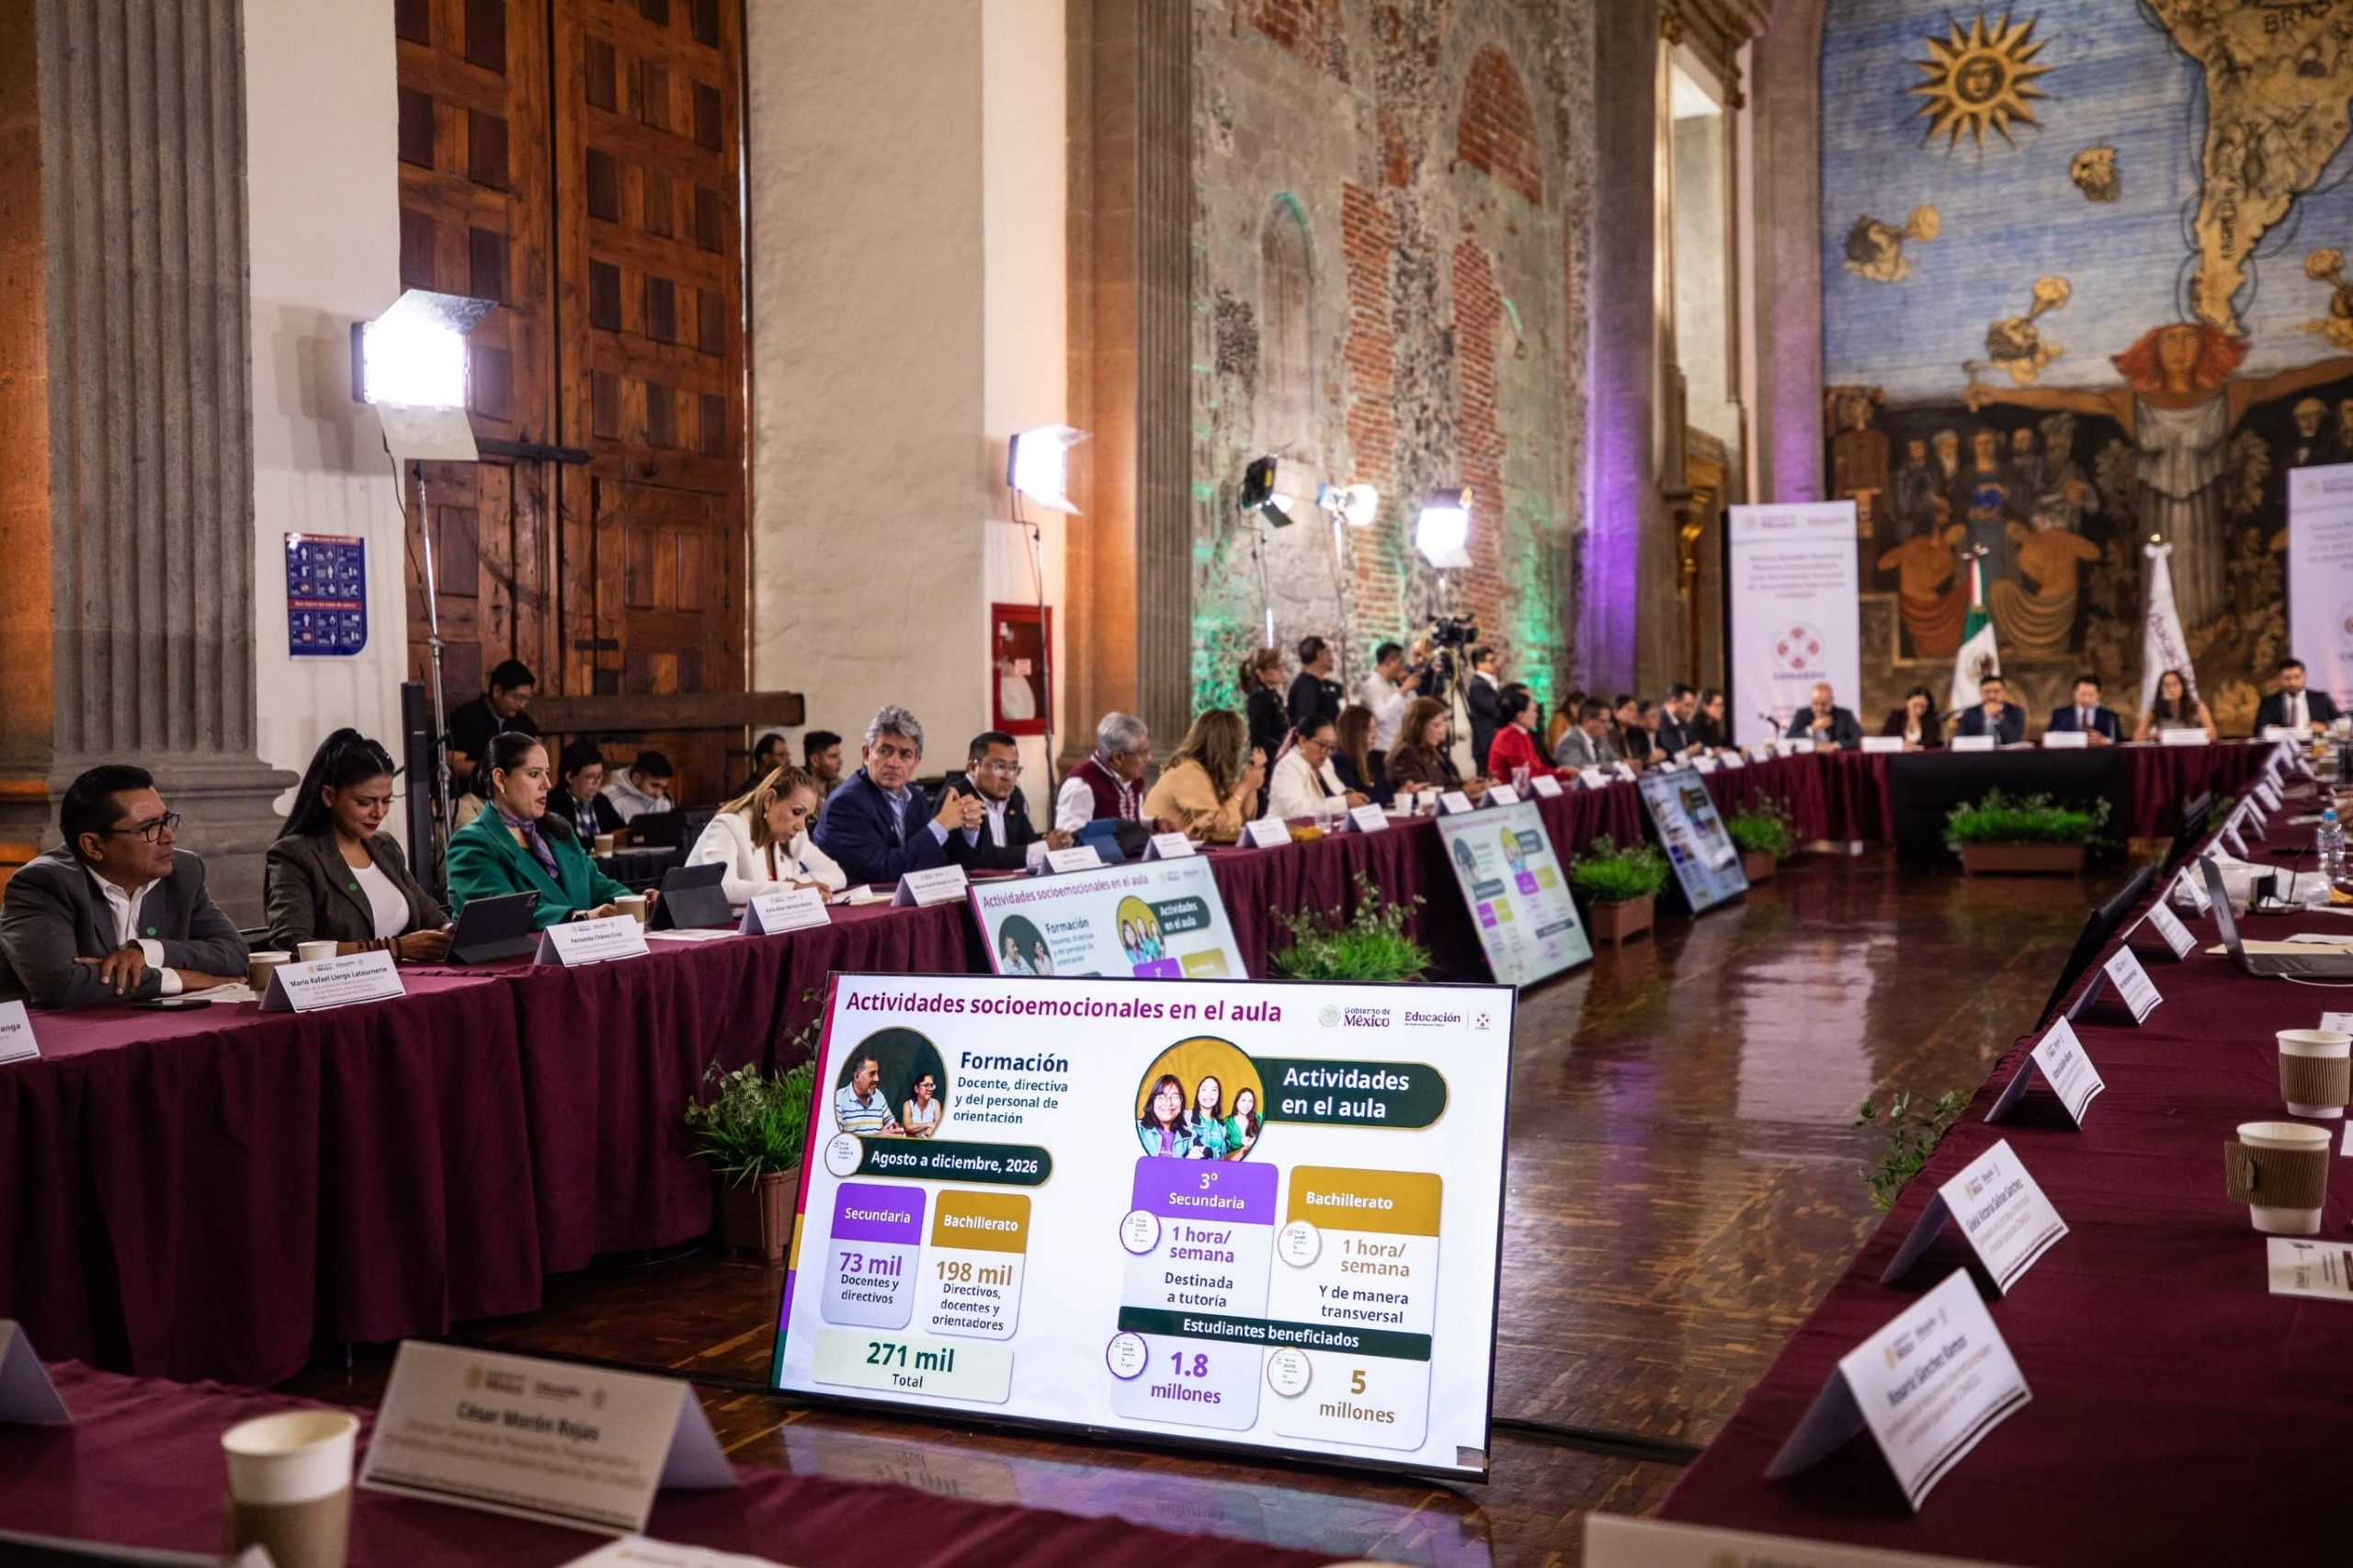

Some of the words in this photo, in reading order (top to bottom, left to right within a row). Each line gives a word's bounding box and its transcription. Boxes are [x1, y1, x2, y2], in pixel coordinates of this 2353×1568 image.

[983, 891, 1036, 908] Actividades
[1037, 880, 1110, 901] socioemocionales
[1111, 880, 1121, 889] en
[1122, 876, 1131, 887] el
[1131, 874, 1149, 885] aula
[1160, 902, 1198, 916] Actividades
[1045, 918, 1089, 934] Formación
[571, 936, 594, 944] Fernanda
[290, 980, 309, 988] Mario
[331, 972, 351, 983] Llergo
[351, 966, 387, 977] Latournerie
[847, 992, 964, 1013] Actividades
[971, 995, 1164, 1018] socioemocionales
[1169, 1002, 1196, 1020] en
[1204, 1000, 1224, 1020] el
[1232, 1001, 1281, 1022] aula
[1345, 1006, 1377, 1015] Gobierno
[1344, 1014, 1390, 1028] México
[1404, 1011, 1461, 1023] Educación
[961, 1051, 1068, 1073] Formación
[958, 1077, 1010, 1092] Docente,
[1014, 1078, 1068, 1092] directiva
[1283, 1067, 1410, 1091] Actividades
[954, 1096, 962, 1107] y
[965, 1093, 983, 1106] del
[986, 1095, 1040, 1109] personal
[1042, 1096, 1058, 1108] de
[1281, 1098, 1307, 1115] en
[1313, 1096, 1333, 1116] el
[1338, 1098, 1386, 1118] aula
[953, 1110, 1023, 1124] orientación
[871, 1151, 917, 1168] Agosto
[920, 1156, 928, 1166] a
[932, 1153, 1002, 1173] diciembre,
[1006, 1159, 1039, 1174] 2026
[1168, 1192, 1245, 1210] Secundaria
[1305, 1191, 1393, 1210] Bachillerato
[845, 1208, 911, 1223] Secundaria
[944, 1214, 1018, 1232] Bachillerato
[1173, 1226, 1179, 1241] 1
[1186, 1226, 1232, 1244] hora/
[1170, 1246, 1234, 1263] semana
[1343, 1239, 1350, 1254] 1
[1358, 1239, 1406, 1257] hora/
[840, 1252, 862, 1273] 73
[869, 1256, 902, 1276] mil
[1341, 1260, 1410, 1278] semana
[841, 1274, 890, 1288] Docentes
[892, 1279, 899, 1291] y
[937, 1261, 972, 1282] 198
[978, 1265, 1013, 1286] mil
[1165, 1272, 1233, 1289] Destinada
[841, 1290, 893, 1304] directivos
[943, 1283, 1001, 1300] Directivos,
[1167, 1293, 1175, 1302] a
[1179, 1292, 1227, 1307] tutoría
[1319, 1285, 1327, 1297] Y
[1331, 1286, 1348, 1300] de
[1353, 1290, 1409, 1305] manera
[940, 1299, 990, 1313] docentes
[992, 1305, 1000, 1316] y
[1322, 1305, 1404, 1324] transversal
[932, 1315, 1004, 1331] orientadores
[1183, 1318, 1265, 1338] Estudiantes
[1268, 1325, 1359, 1347] beneficiados
[867, 1342, 907, 1368] 271
[915, 1348, 955, 1372] mil
[1170, 1351, 1209, 1378] 1.8
[892, 1373, 923, 1388] Total
[1350, 1369, 1367, 1394] 5
[1151, 1383, 1222, 1404] millones
[456, 1400, 498, 1423] César
[557, 1417, 600, 1443] Rojas
[1320, 1402, 1394, 1424] millones
